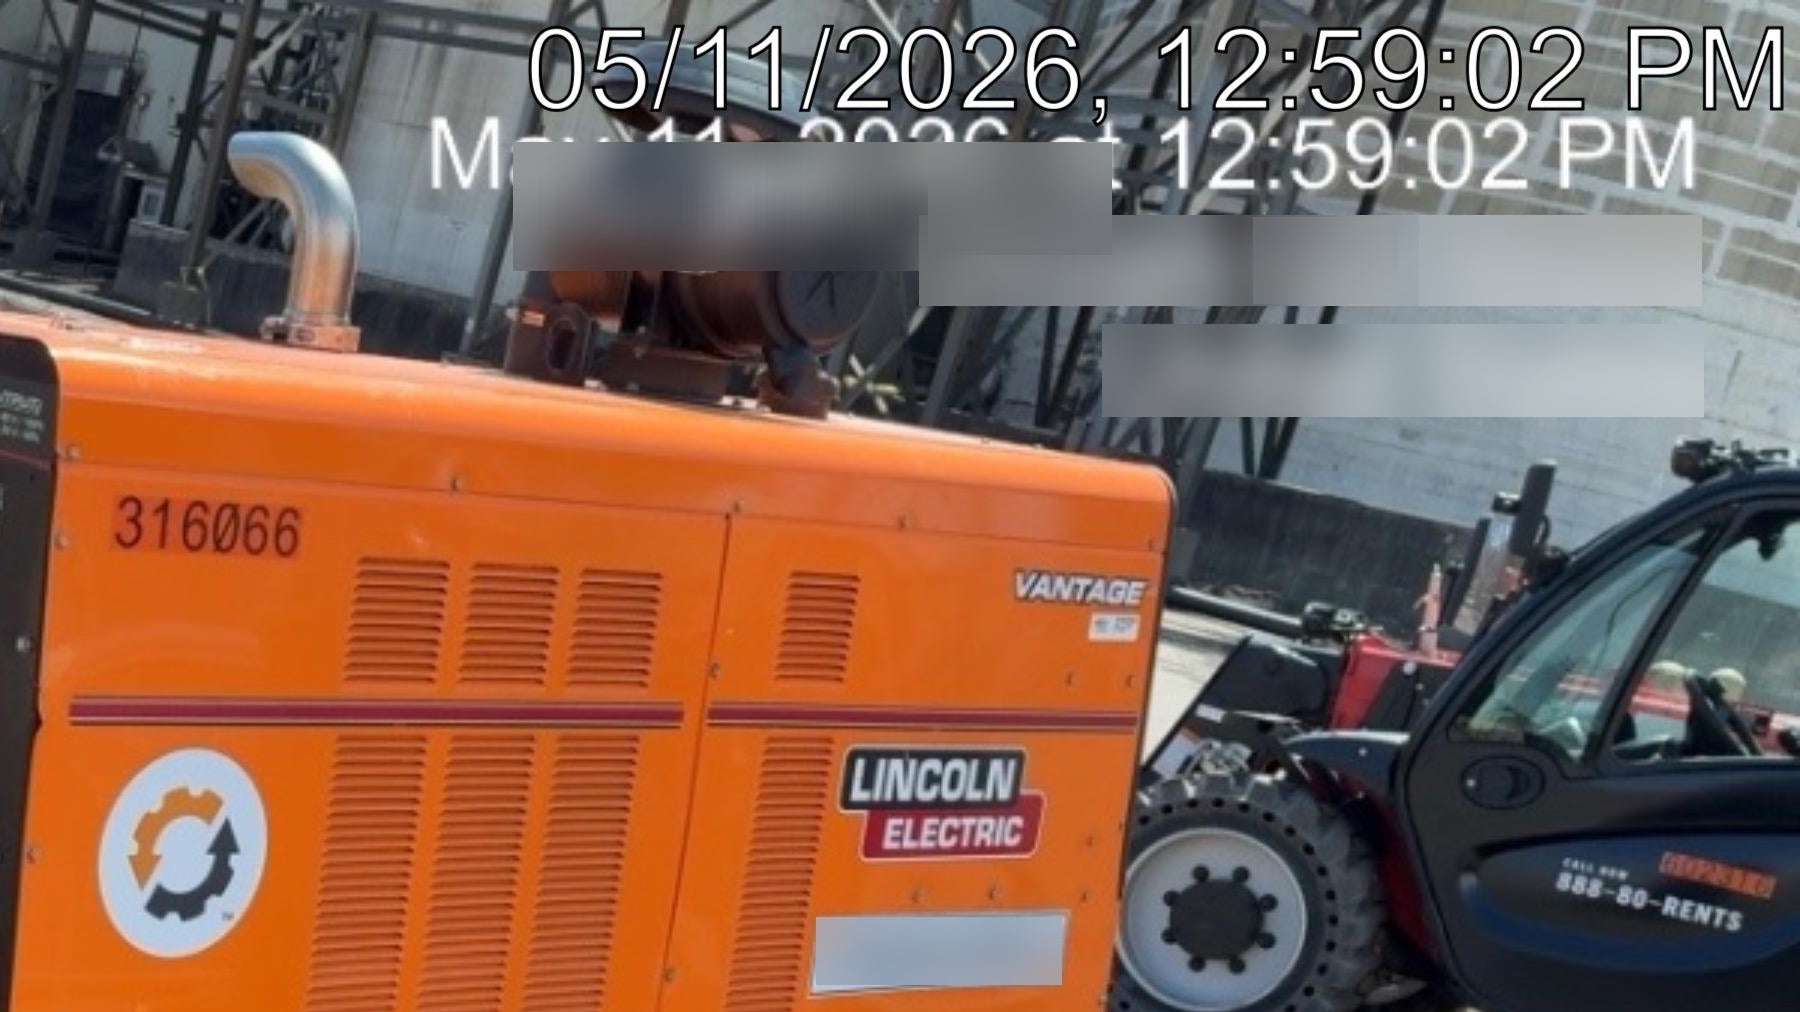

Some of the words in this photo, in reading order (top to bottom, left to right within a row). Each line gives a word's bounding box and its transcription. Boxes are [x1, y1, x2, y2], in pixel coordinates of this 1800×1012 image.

[1014, 569, 1148, 607] VANTAGE
[850, 756, 1017, 803] LINCOLN
[881, 815, 1025, 851] ELECTRIC
[1555, 871, 1744, 932] 888-80-RENTS
